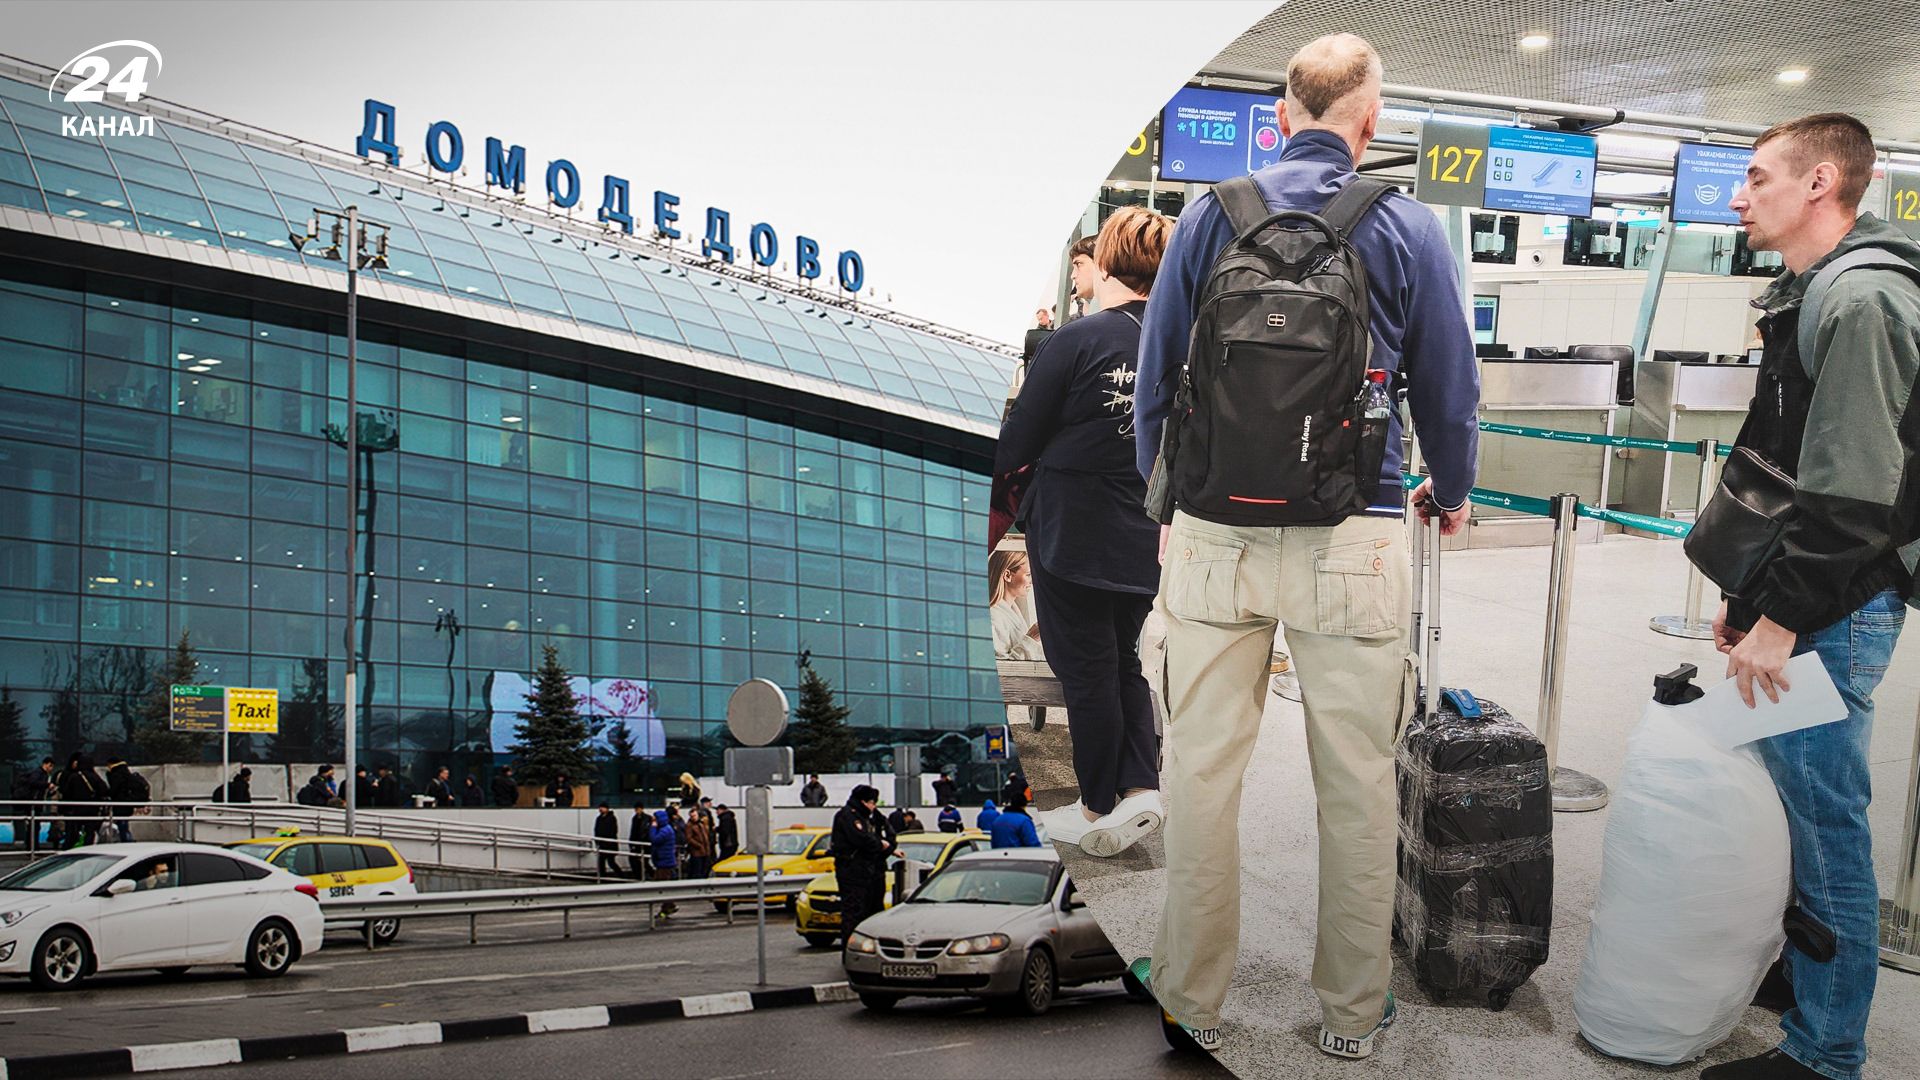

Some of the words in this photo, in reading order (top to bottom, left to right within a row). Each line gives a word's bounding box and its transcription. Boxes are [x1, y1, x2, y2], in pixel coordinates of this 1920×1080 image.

[1427, 144, 1483, 184] 127
[1575, 169, 1582, 178] 2
[356, 98, 865, 292] ДОМОДЕДОВО
[1894, 189, 1920, 220] 12
[1300, 442, 1310, 462] Road
[236, 703, 271, 718] Taxi
[1322, 1031, 1360, 1053] LDN
